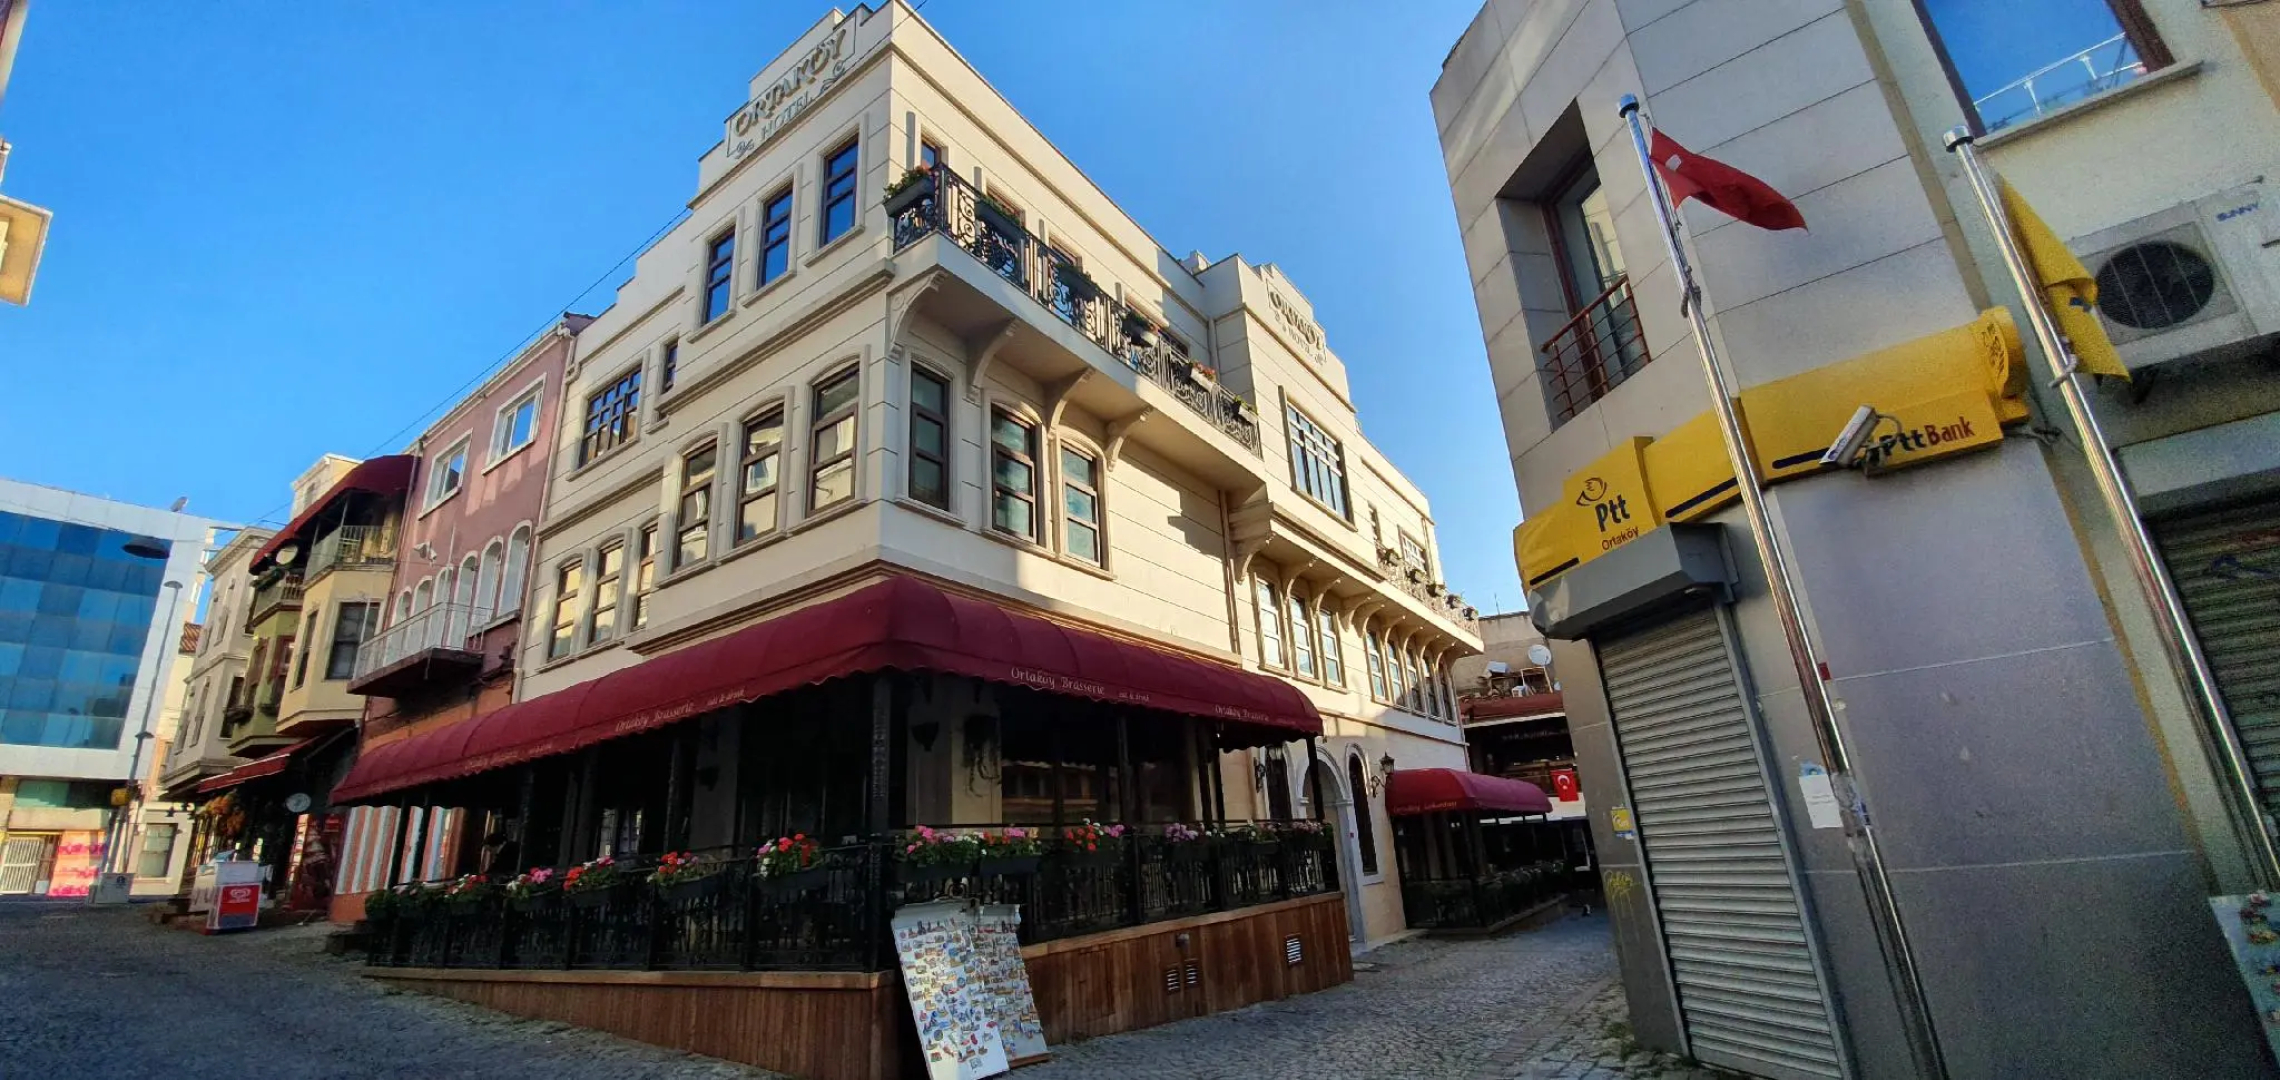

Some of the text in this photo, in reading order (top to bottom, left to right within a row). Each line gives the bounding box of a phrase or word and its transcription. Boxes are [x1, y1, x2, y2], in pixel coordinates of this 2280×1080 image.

[761, 90, 814, 141] HOTEL
[1602, 526, 1639, 551] Ortaköy
[1061, 676, 1105, 695] Brasserie
